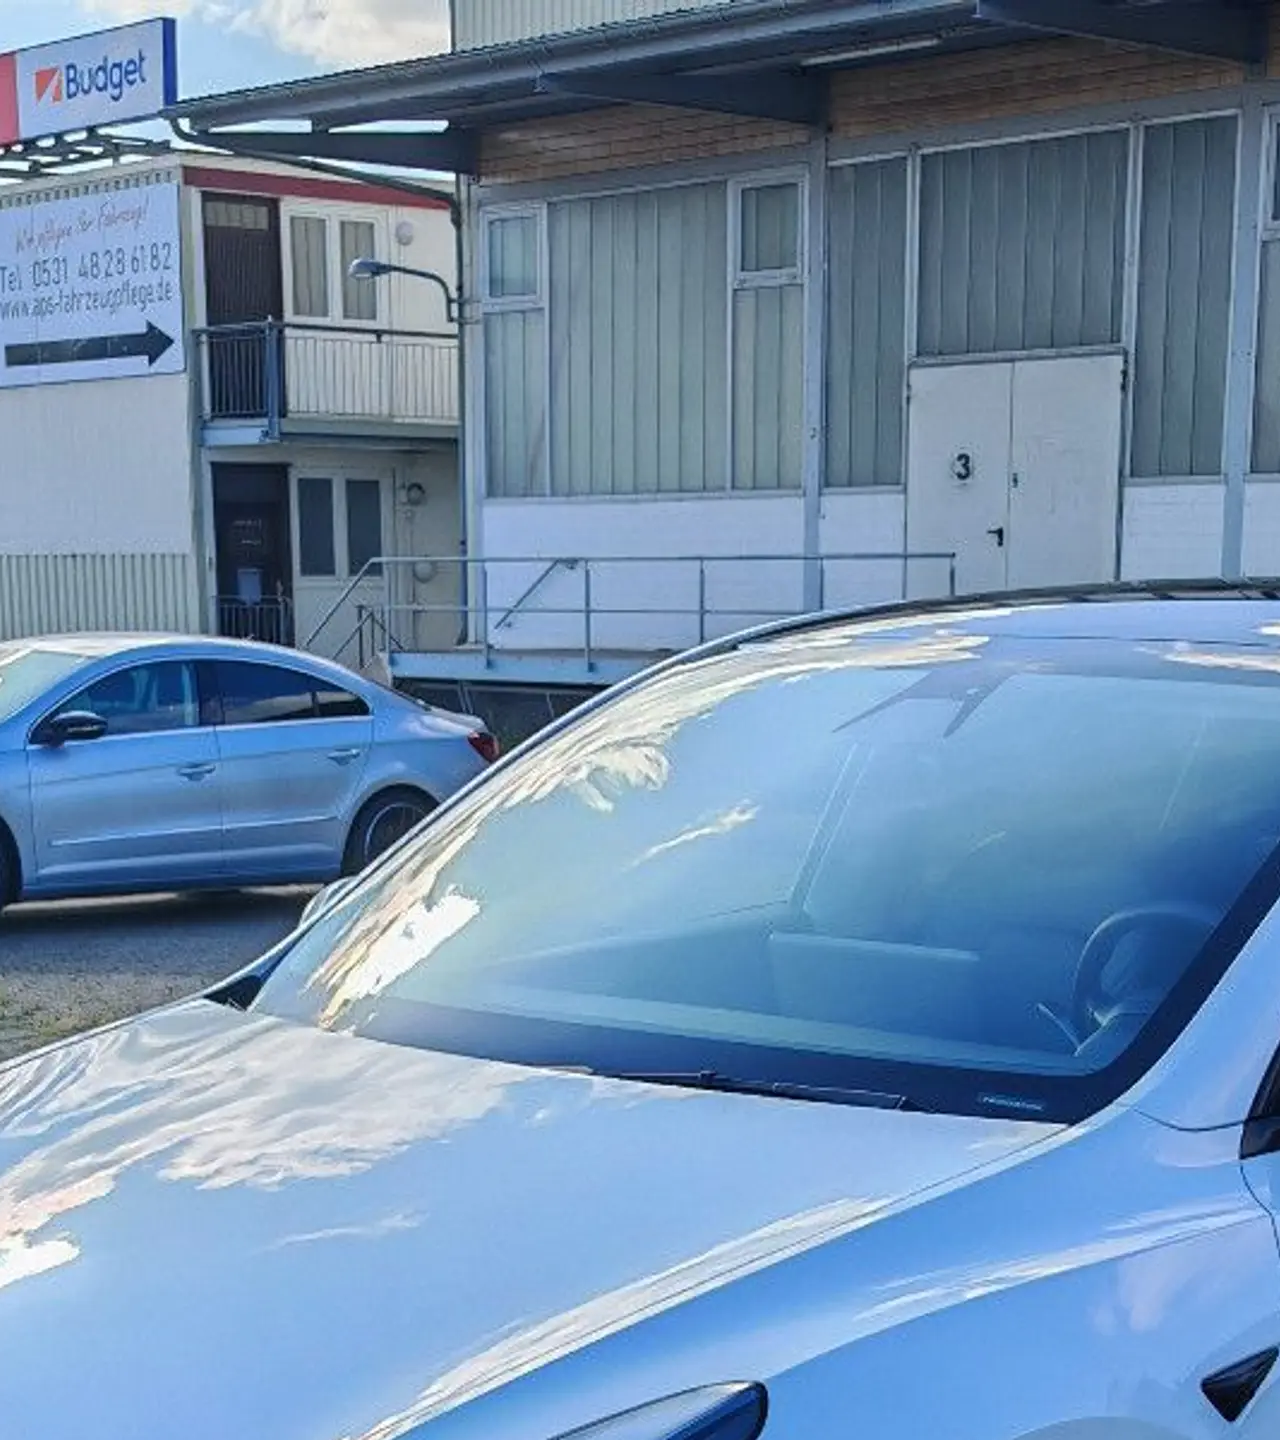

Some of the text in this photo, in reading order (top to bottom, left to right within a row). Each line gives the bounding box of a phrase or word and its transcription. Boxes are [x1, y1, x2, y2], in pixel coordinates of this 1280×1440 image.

[65, 49, 147, 101] Budget
[32, 257, 69, 288] 0531
[0, 275, 173, 321] www.aps-fahrzeugpflege.de
[955, 453, 971, 480] 3
